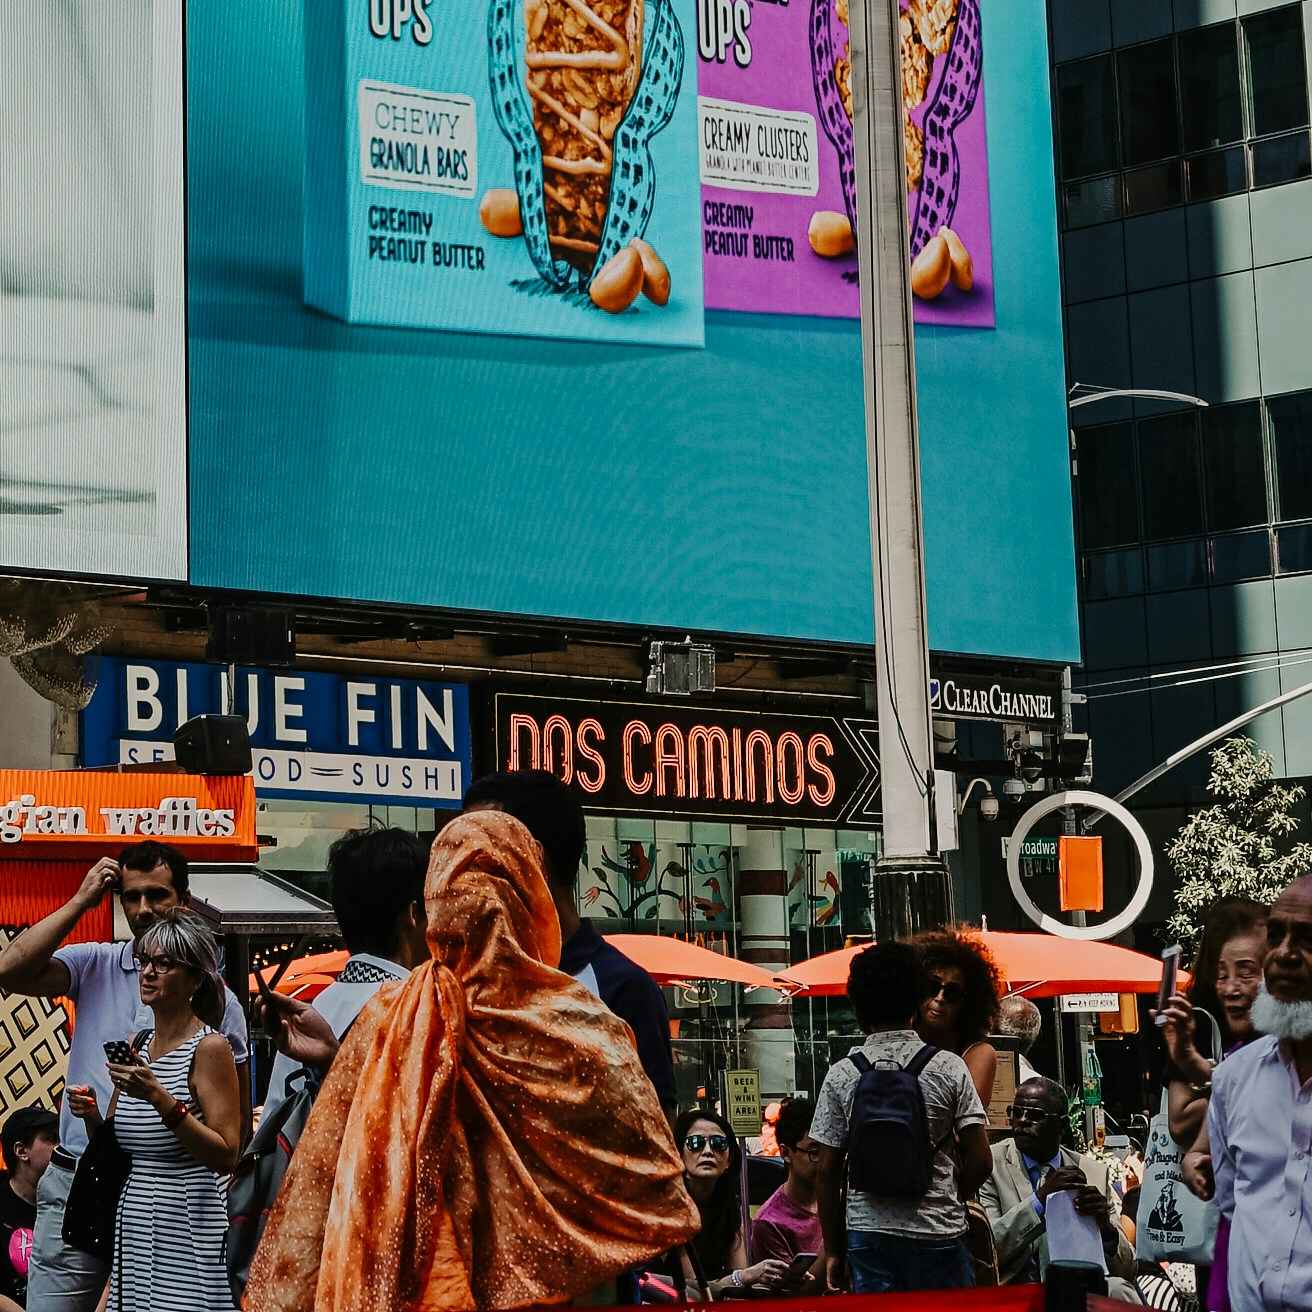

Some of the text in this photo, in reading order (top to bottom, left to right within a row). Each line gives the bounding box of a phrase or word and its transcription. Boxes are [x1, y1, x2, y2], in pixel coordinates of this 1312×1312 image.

[375, 102, 461, 140] CHEWY
[704, 116, 810, 163] CREAMY CLUSTERS
[370, 137, 469, 182] GRANOLA BARS
[368, 205, 433, 236] CREAMY
[704, 200, 754, 230] CREAMY
[368, 235, 486, 271] PEANUT BUTTER
[704, 229, 795, 262] PEANUT BUTTER
[346, 680, 456, 753] FIN
[352, 761, 457, 792] SUSHI
[623, 720, 837, 807] CAMINOS
[99, 797, 238, 838] waffles
[1020, 840, 1058, 855] roadwa
[734, 1078, 755, 1086] BEER
[735, 1095, 756, 1103] WINE
[735, 1107, 757, 1116] AREA
